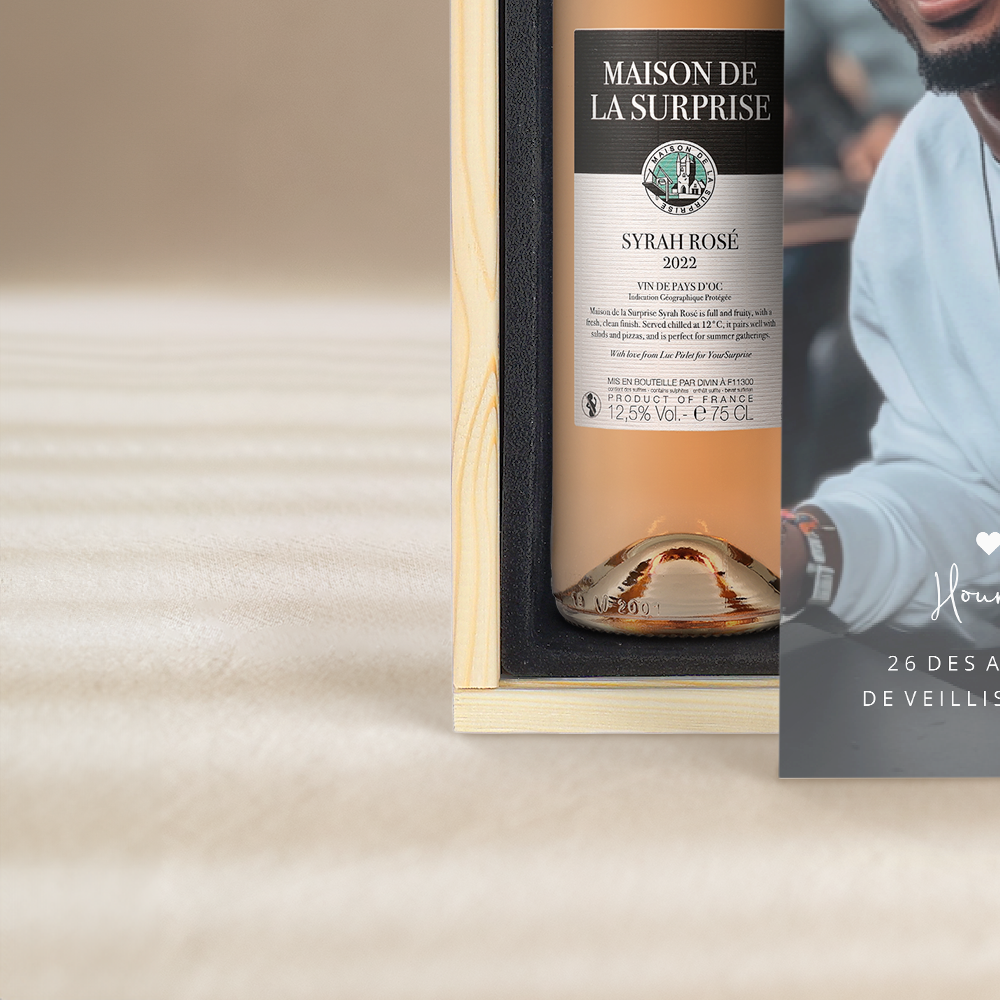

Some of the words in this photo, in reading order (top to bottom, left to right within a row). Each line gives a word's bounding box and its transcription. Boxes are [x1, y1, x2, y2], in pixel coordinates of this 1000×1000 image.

[603, 61, 712, 86] MAISON
[719, 61, 757, 86] DE
[591, 94, 626, 121] LA
[631, 94, 771, 121] SURPRISE
[651, 145, 692, 164] MAISON
[697, 152, 708, 164] DE
[622, 233, 684, 250] SYRAH
[690, 229, 739, 250] ROSÉ
[663, 257, 697, 269] 2022
[637, 282, 654, 291] VIN
[656, 282, 671, 291] DE
[672, 282, 696, 291] PAYS
[660, 294, 704, 302] Géographique
[705, 294, 731, 302] Protégée
[590, 307, 611, 316] Maison
[612, 308, 619, 316] de
[627, 309, 657, 318] Surprise
[658, 309, 678, 319] Syrah
[680, 309, 698, 317] Rosé
[707, 309, 718, 317] full
[720, 309, 732, 317] and
[603, 319, 619, 327] clean
[620, 320, 640, 328] finish.
[733, 321, 749, 330] pairs
[622, 331, 645, 340] pizzas,
[661, 332, 666, 340] is
[668, 332, 694, 342] perfect
[695, 332, 705, 340] for
[627, 350, 641, 358] love
[640, 351, 658, 360] from
[694, 351, 706, 361] for
[708, 351, 752, 360] YourSurprise
[720, 377, 725, 386] À
[608, 394, 669, 403] PRODUCT
[703, 395, 753, 403] FRANCE
[608, 405, 651, 422] 12,5%
[711, 406, 729, 421] 75
[734, 405, 754, 421] CL
[887, 655, 917, 672] 26
[928, 655, 975, 672] DES
[863, 690, 894, 706] DE
